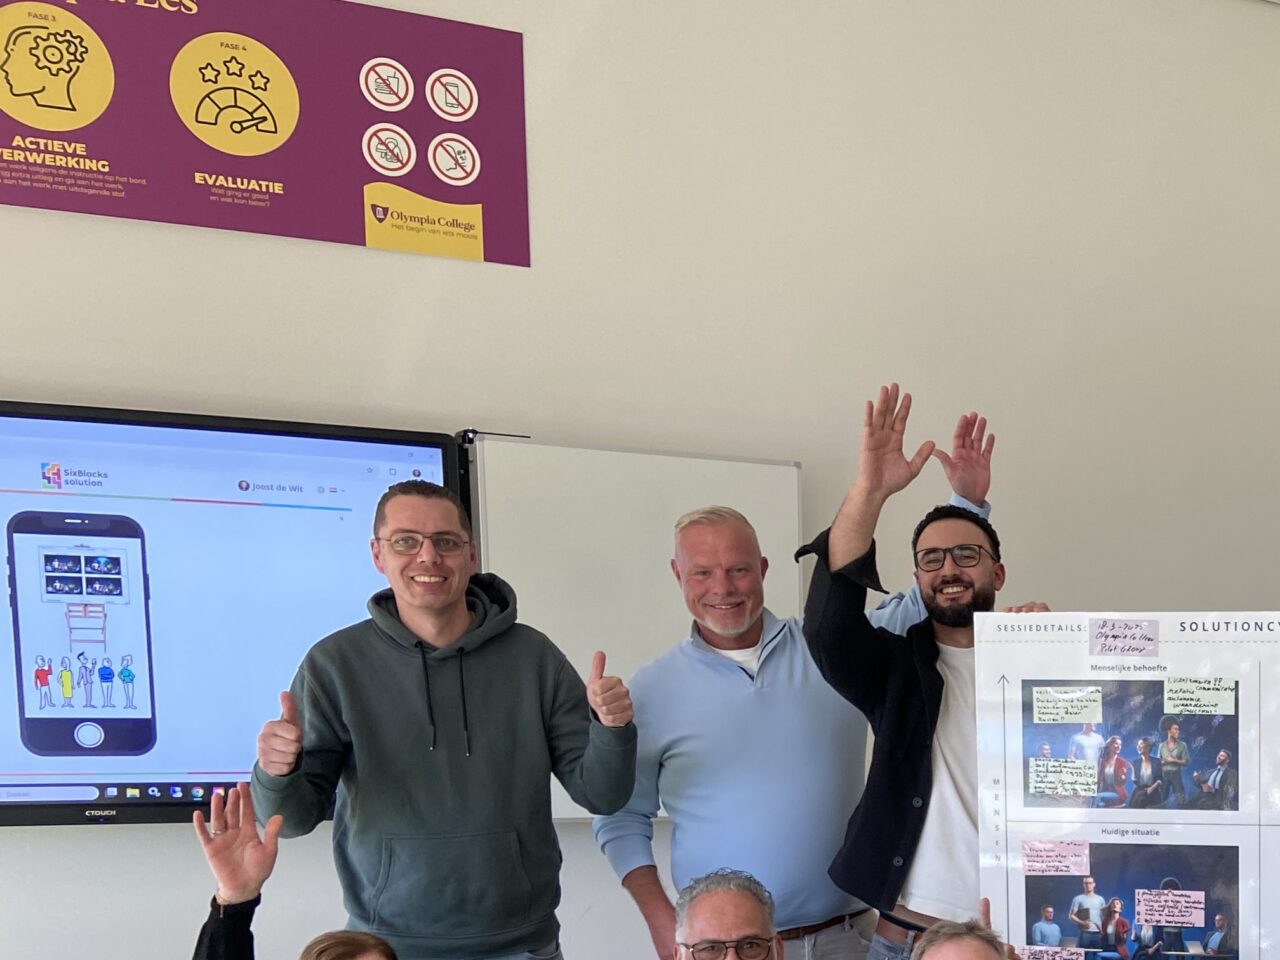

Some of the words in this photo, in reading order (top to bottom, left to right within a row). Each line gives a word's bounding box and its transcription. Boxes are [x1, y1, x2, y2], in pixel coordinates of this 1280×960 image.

[27, 12, 50, 22] FASE
[220, 41, 241, 51] FASE
[11, 135, 87, 155] ACTIEVE
[0, 148, 110, 172] ERWERKING
[11, 171, 31, 179] extra
[29, 166, 57, 175] volgens
[32, 182, 51, 190] werk
[194, 172, 284, 194] EVALUATIE
[390, 210, 436, 226] Olympia
[437, 217, 476, 233] College
[64, 468, 108, 479] SixBlocks
[64, 479, 103, 487] solution
[252, 482, 275, 491] Joost
[288, 485, 304, 493] Wit
[997, 624, 1087, 632] SESSIEDETAILS:
[1090, 664, 1132, 673] Menselijke
[1133, 664, 1168, 672] behoefte
[1101, 828, 1130, 837] Huidige
[1131, 828, 1160, 836] situatie
